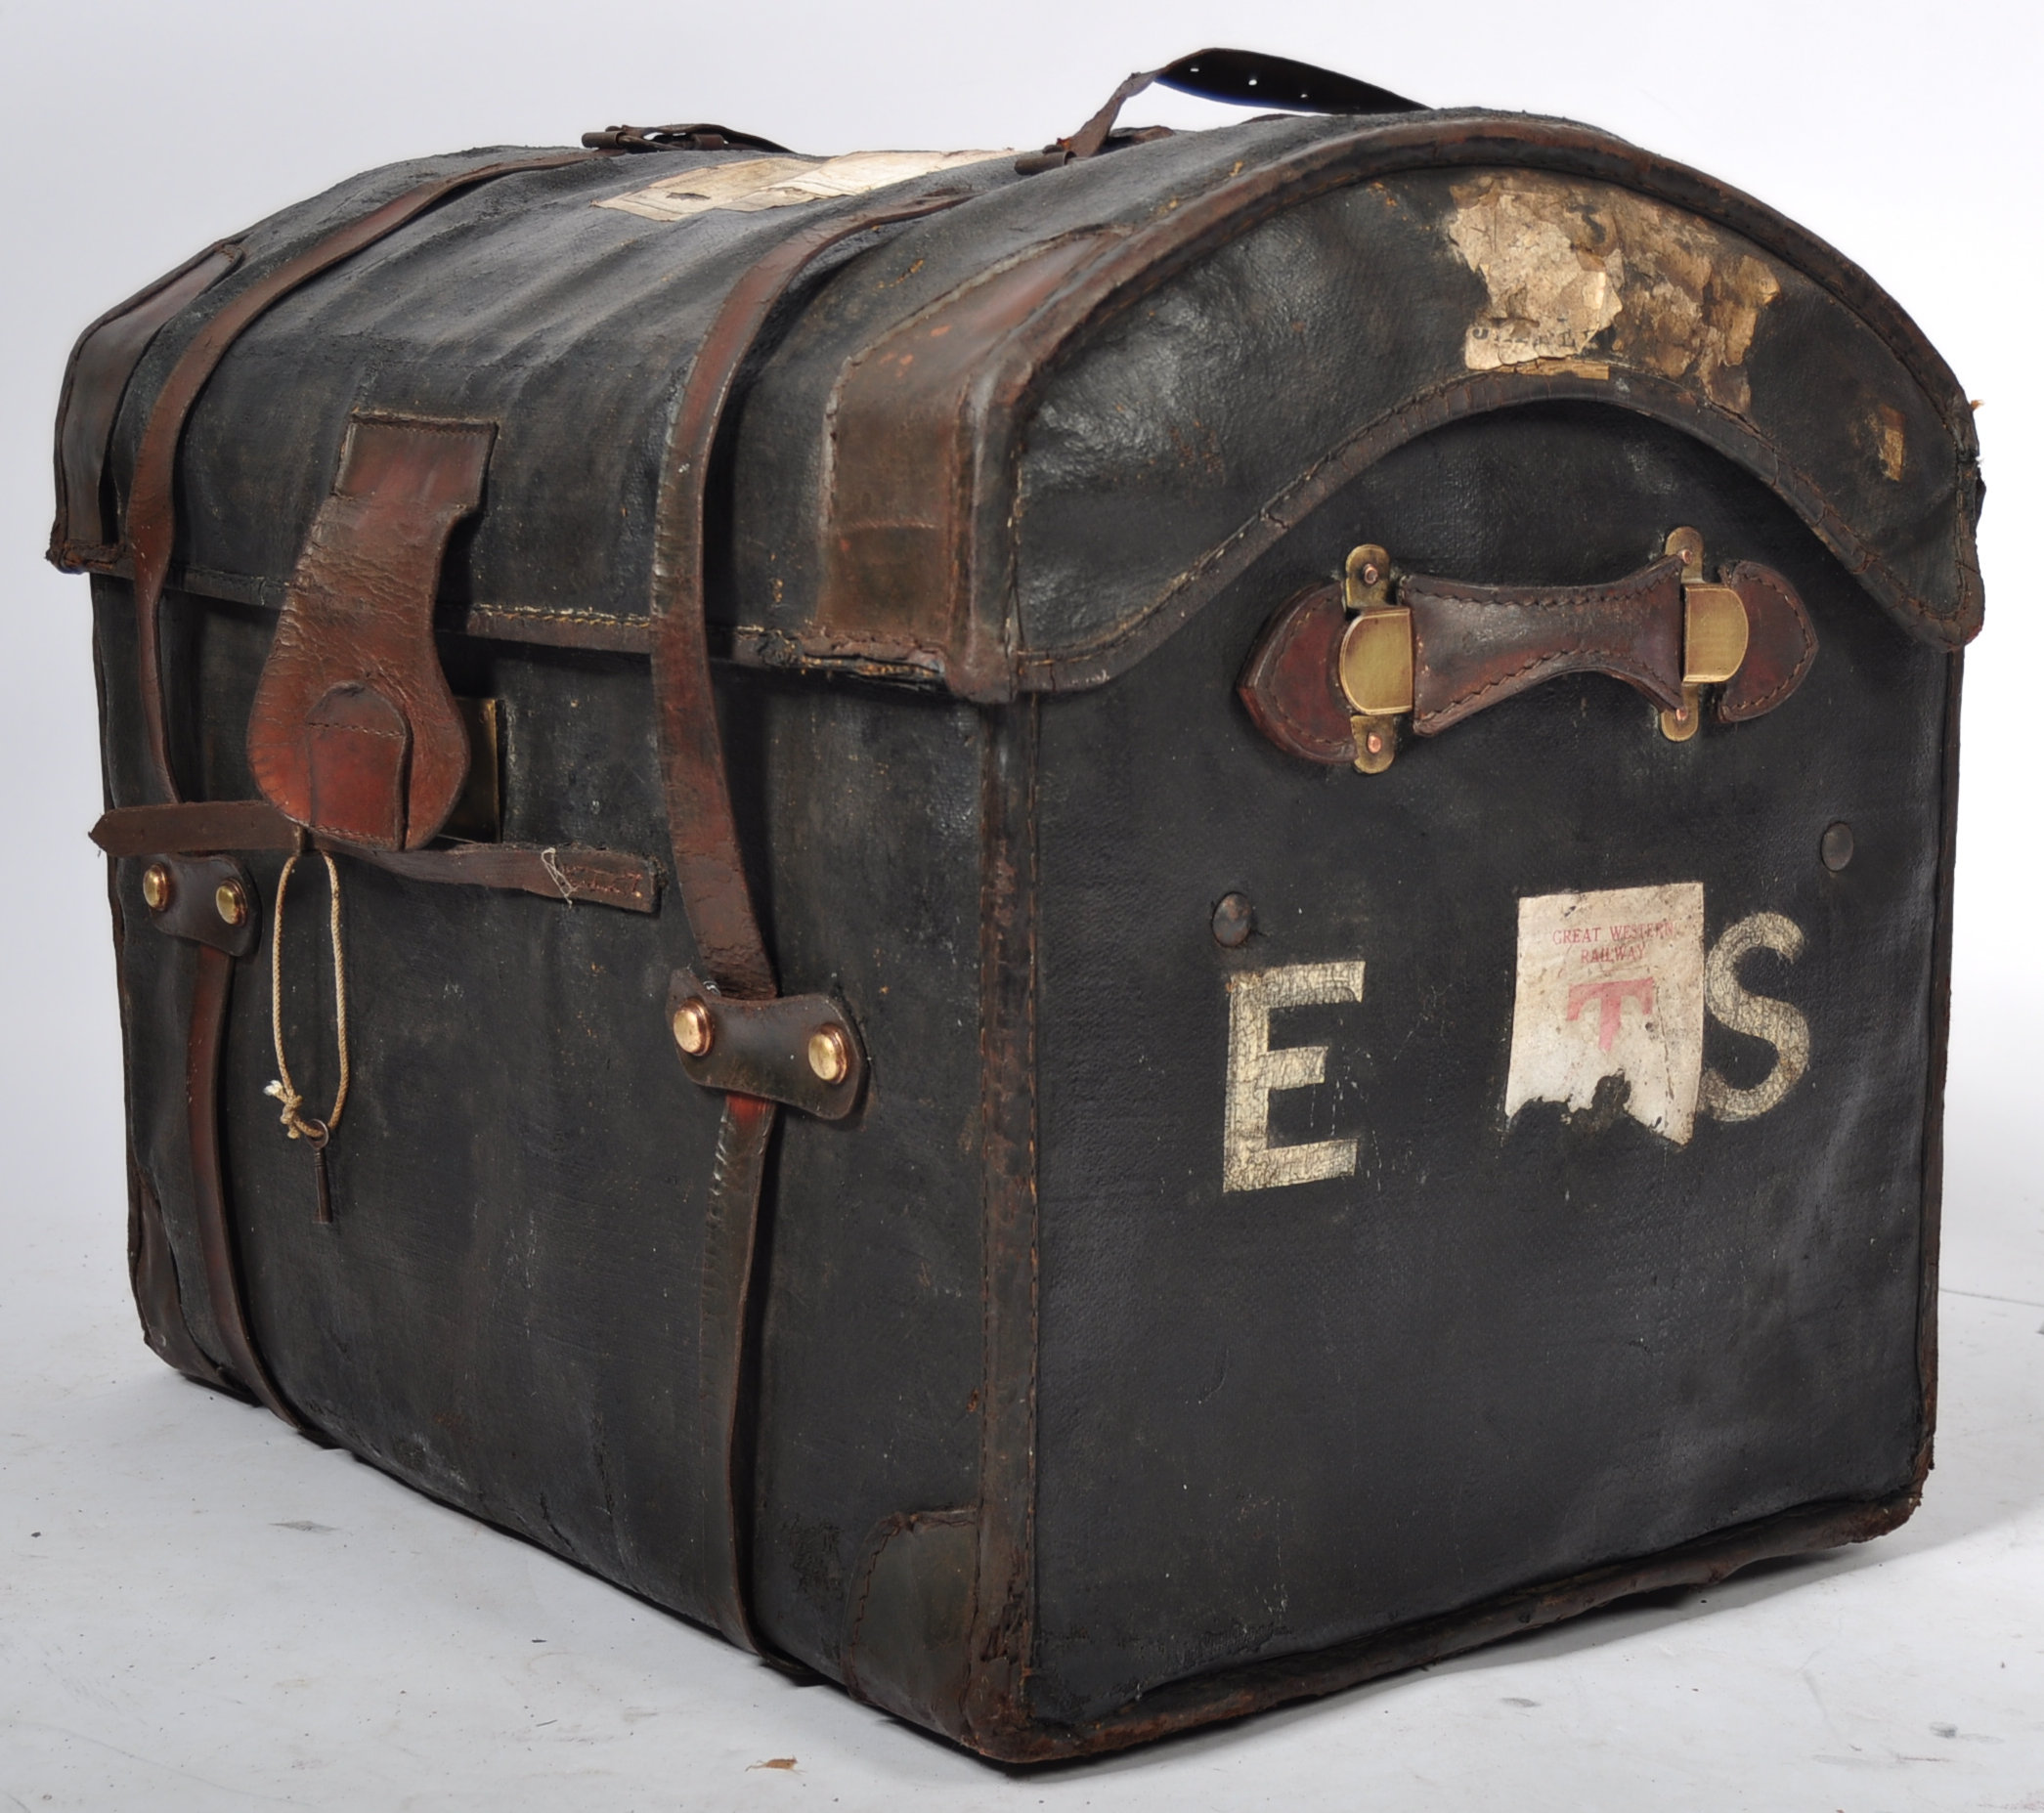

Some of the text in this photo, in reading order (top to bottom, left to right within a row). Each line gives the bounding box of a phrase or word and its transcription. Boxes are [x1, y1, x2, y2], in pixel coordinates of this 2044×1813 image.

[1552, 921, 1674, 945] GREAT WESTERN
[1581, 943, 1646, 964] RAILWAY
[1565, 976, 1654, 1052] T
[1223, 910, 1810, 1193] E S
